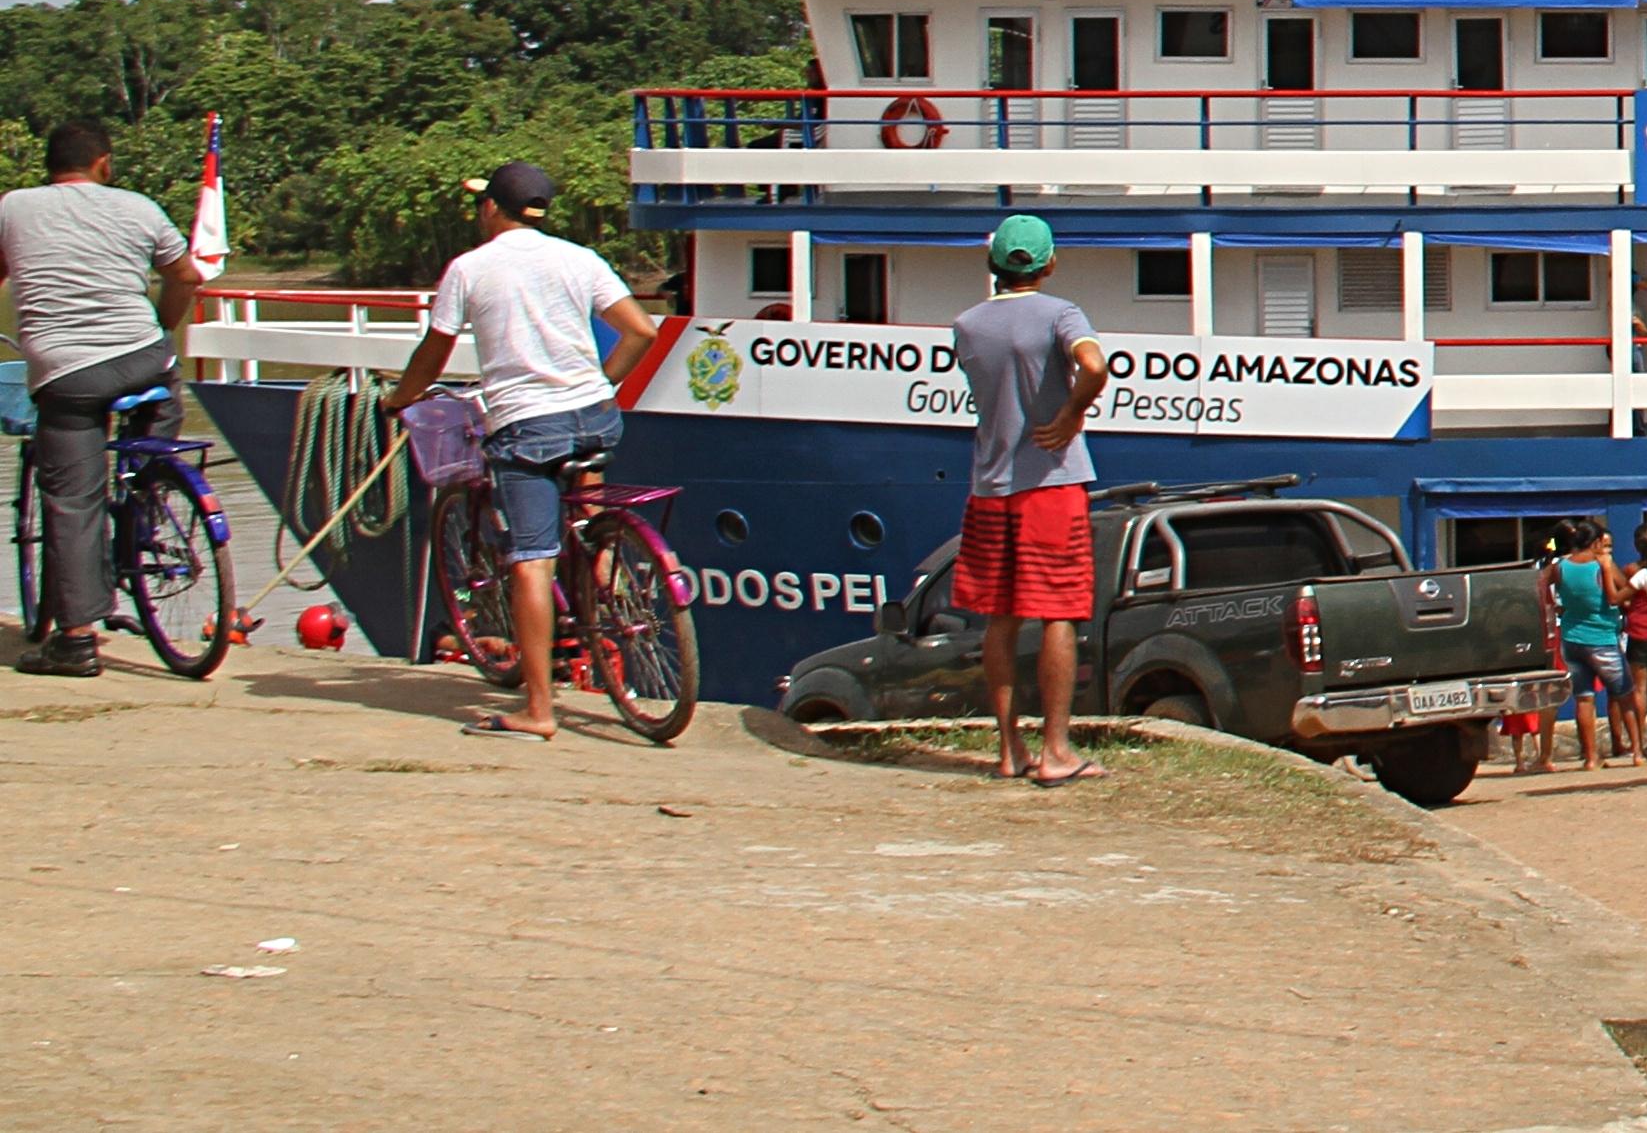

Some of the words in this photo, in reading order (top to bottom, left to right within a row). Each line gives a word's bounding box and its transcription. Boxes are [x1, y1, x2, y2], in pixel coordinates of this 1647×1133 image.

[751, 337, 922, 372] GOVERNO
[1144, 352, 1202, 381] DO
[1208, 354, 1420, 387] AMAZONAS
[907, 381, 977, 414] Gove
[1110, 388, 1243, 423] Pessoas
[1166, 595, 1284, 628] ATTACK
